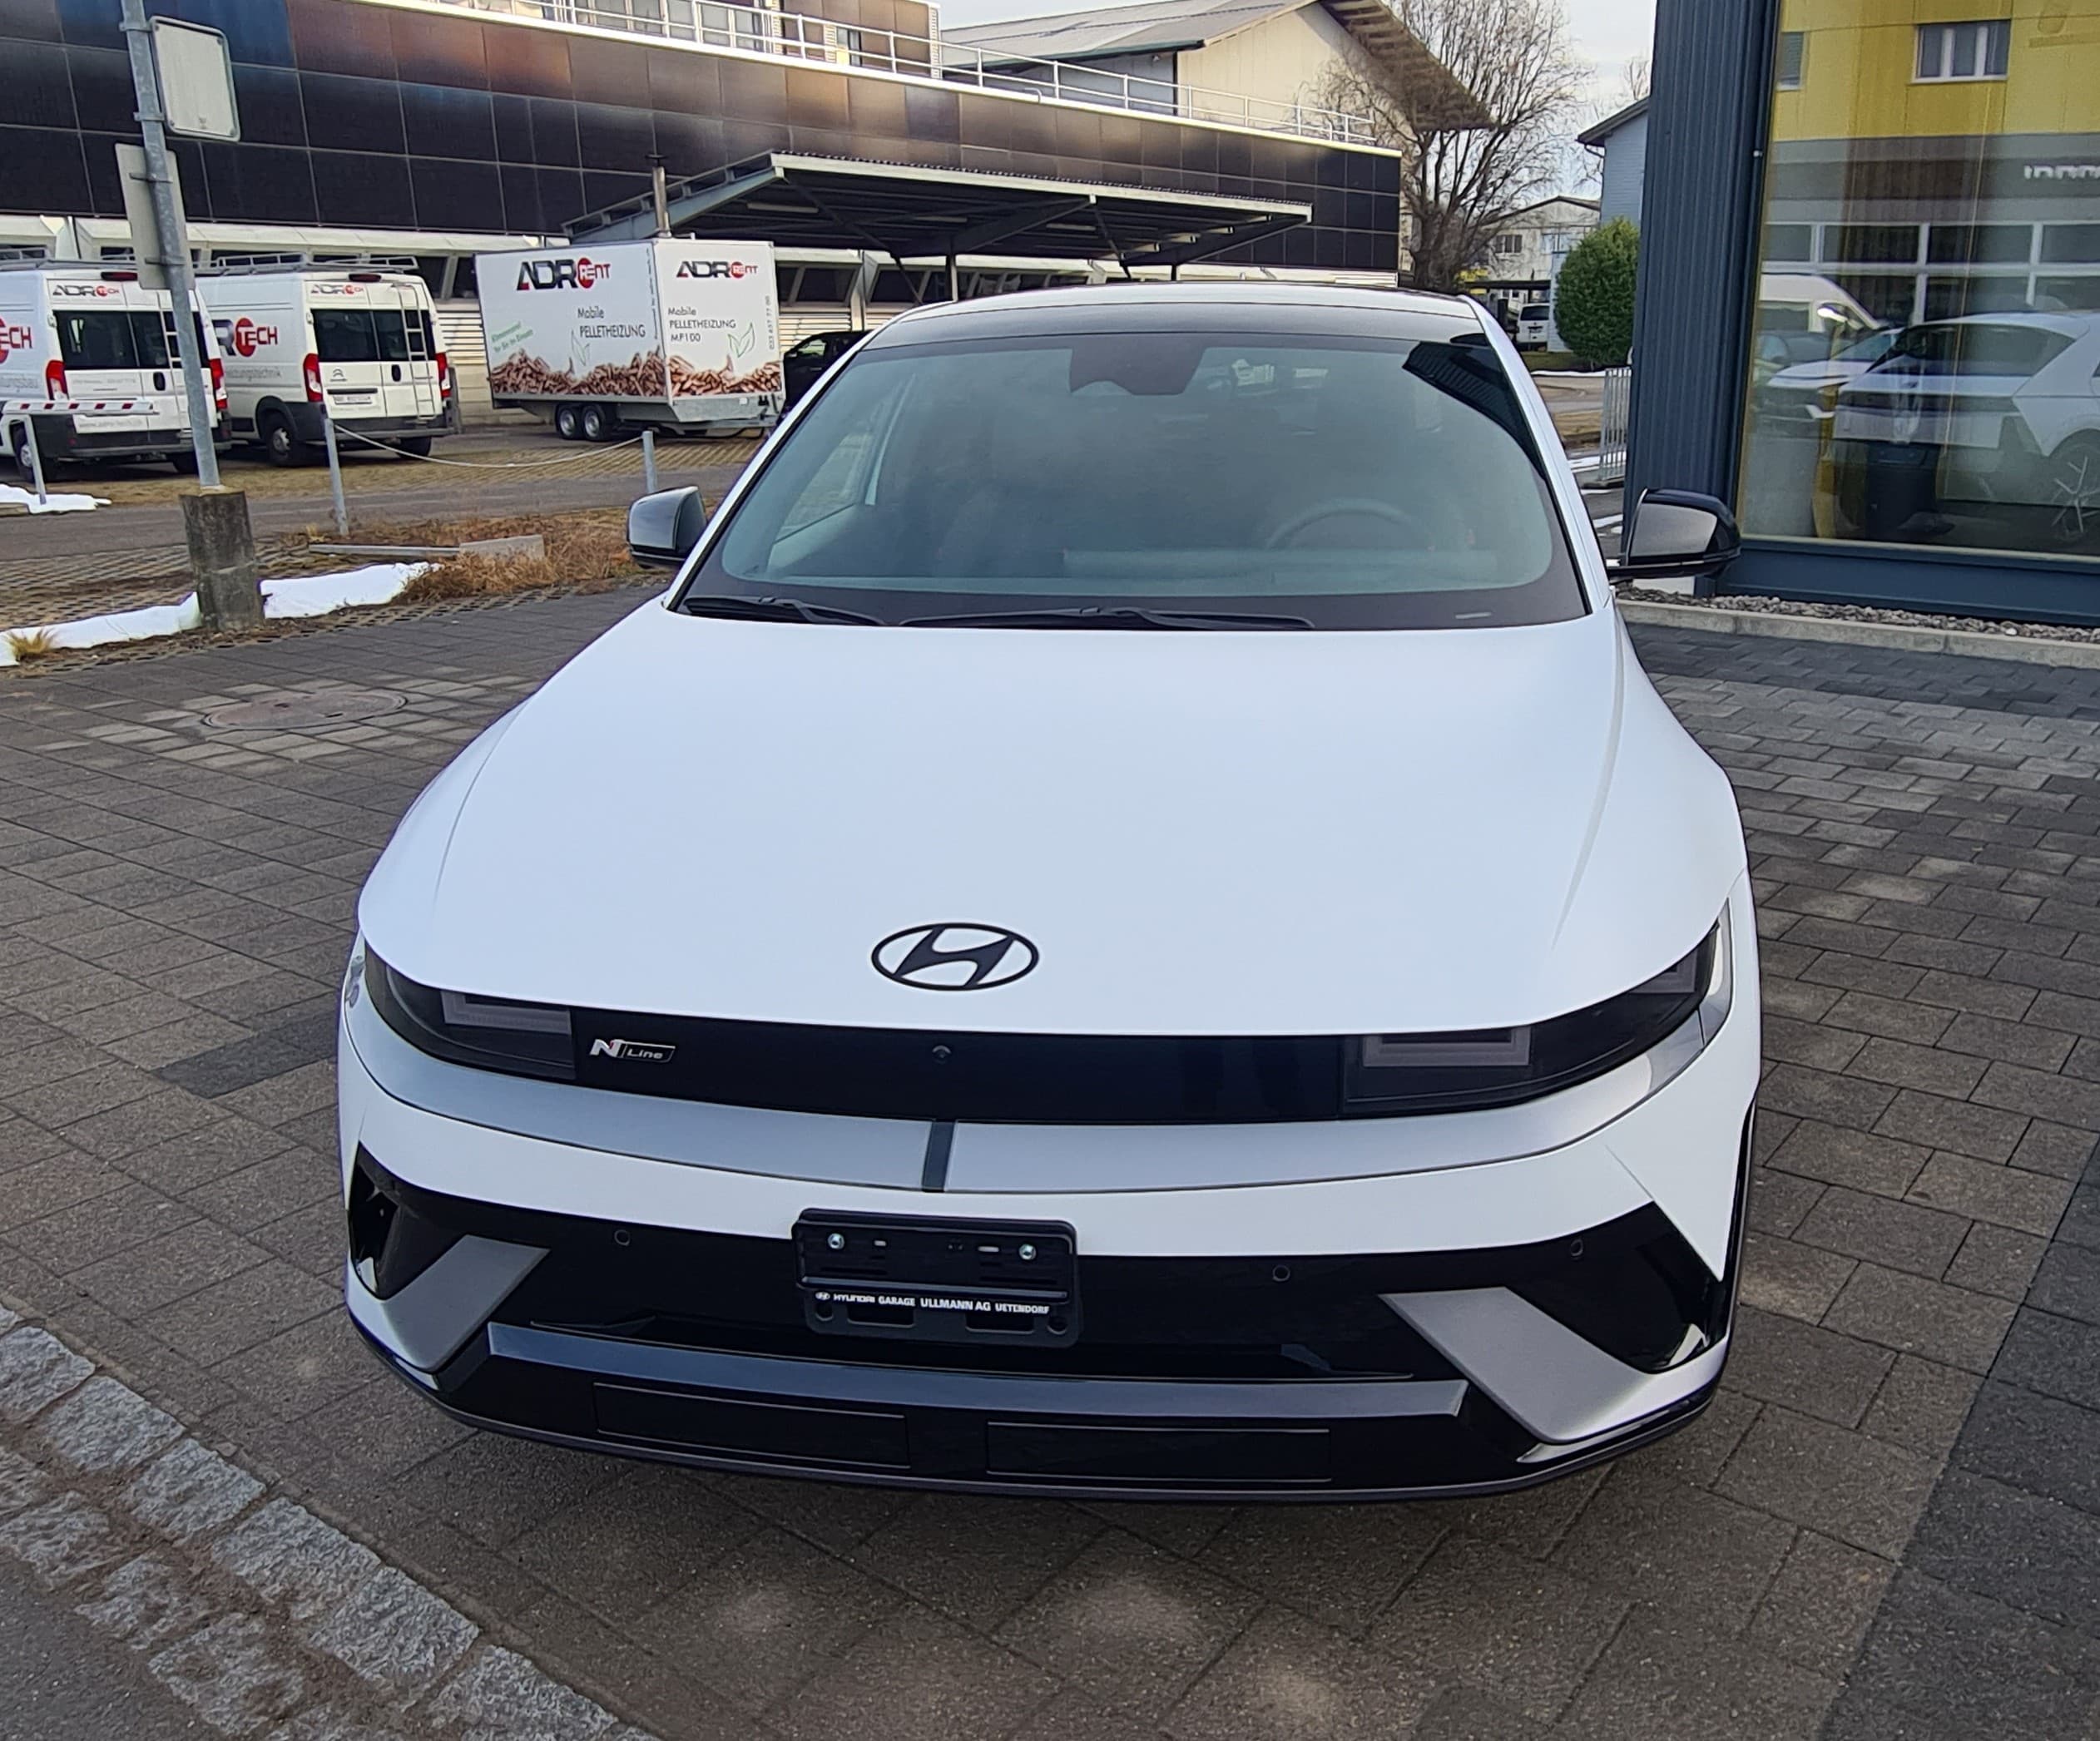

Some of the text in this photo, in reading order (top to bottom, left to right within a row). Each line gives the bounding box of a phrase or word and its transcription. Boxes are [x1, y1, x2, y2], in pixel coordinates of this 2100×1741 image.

[577, 305, 605, 319] Mobile
[667, 306, 697, 316] Mobile
[669, 319, 736, 329] PELLETHEIZUNG
[0, 326, 32, 349] ECH
[580, 324, 646, 339] PELLETHEIZUNG
[627, 1048, 664, 1059] Line
[833, 1293, 1050, 1315] HYUNDAI GARAGE ULLMANN AG UETENDORF
